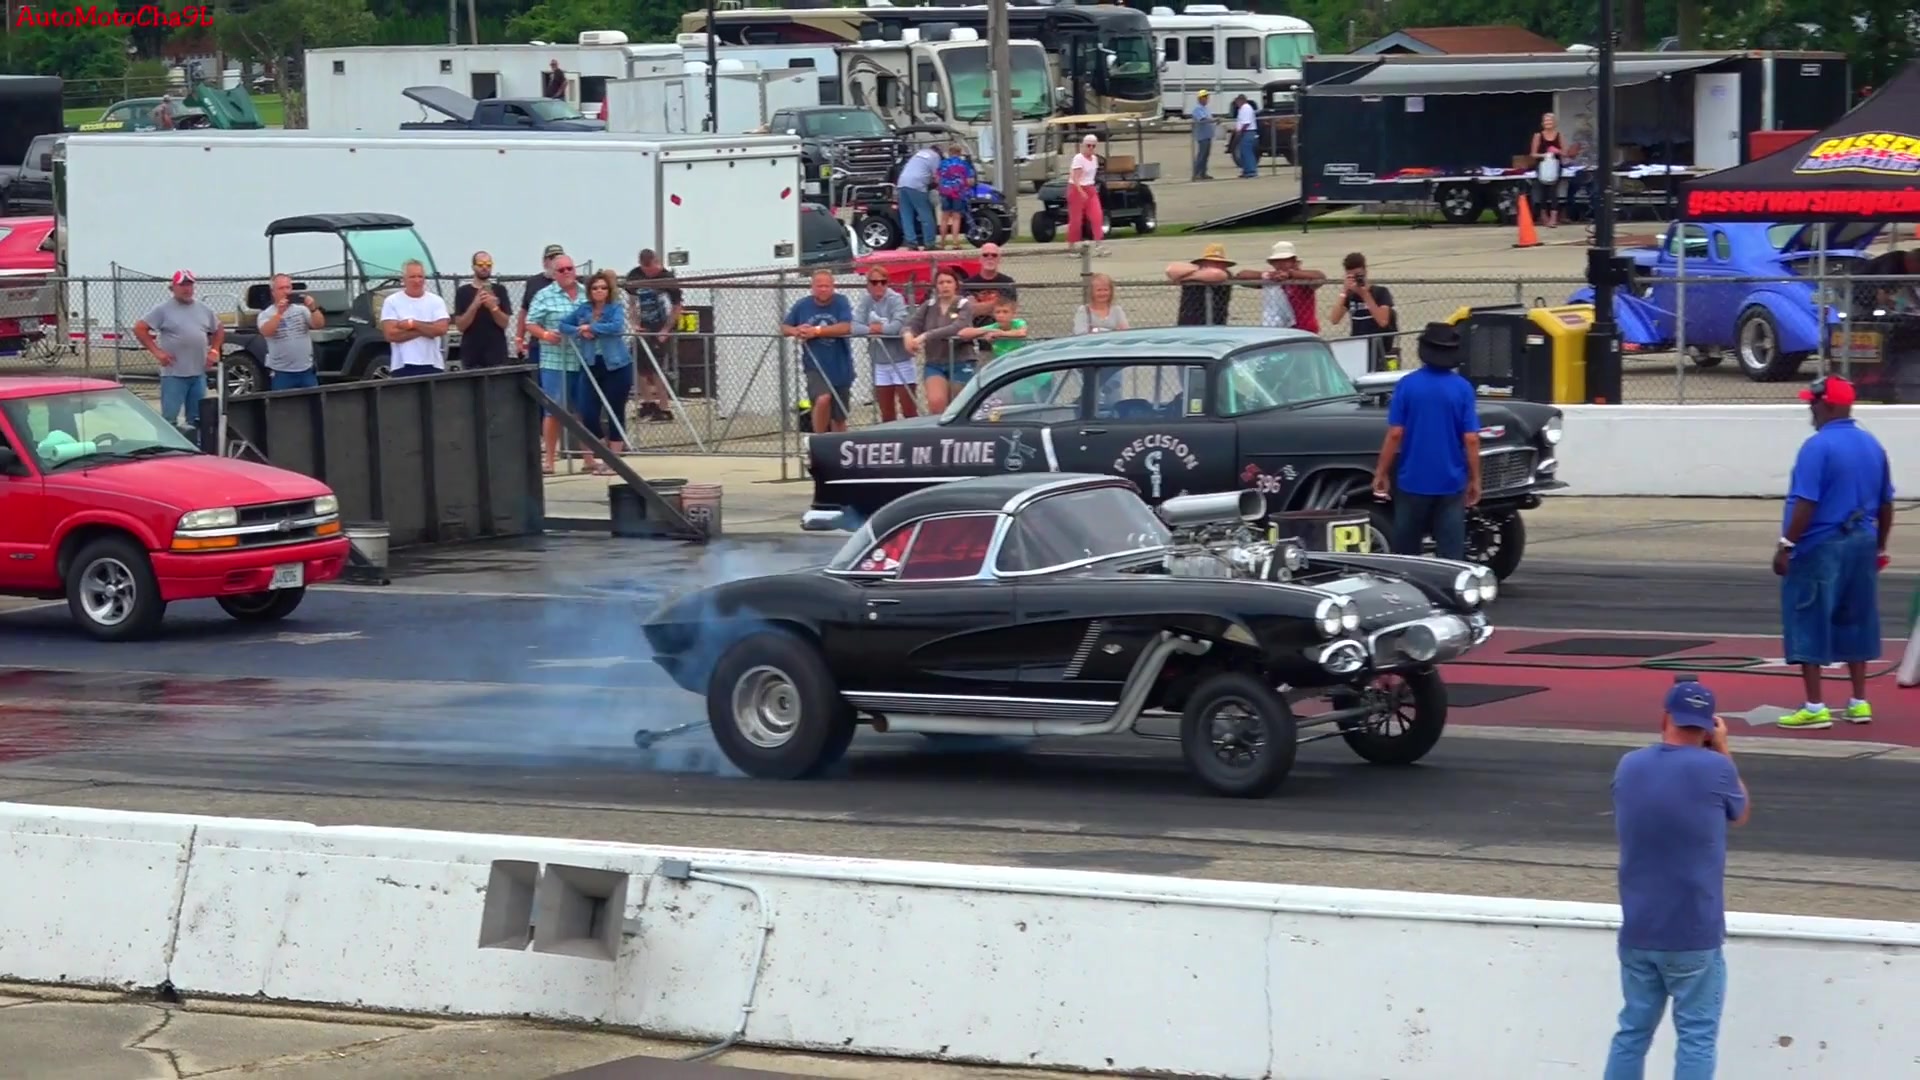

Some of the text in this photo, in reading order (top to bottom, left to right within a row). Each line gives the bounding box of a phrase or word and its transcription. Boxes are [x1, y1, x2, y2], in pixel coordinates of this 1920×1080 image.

[840, 440, 905, 467] STEEL
[911, 446, 933, 466] IN
[940, 438, 996, 464] TIME
[1113, 434, 1199, 473] PRECISION
[1255, 473, 1282, 494] 396
